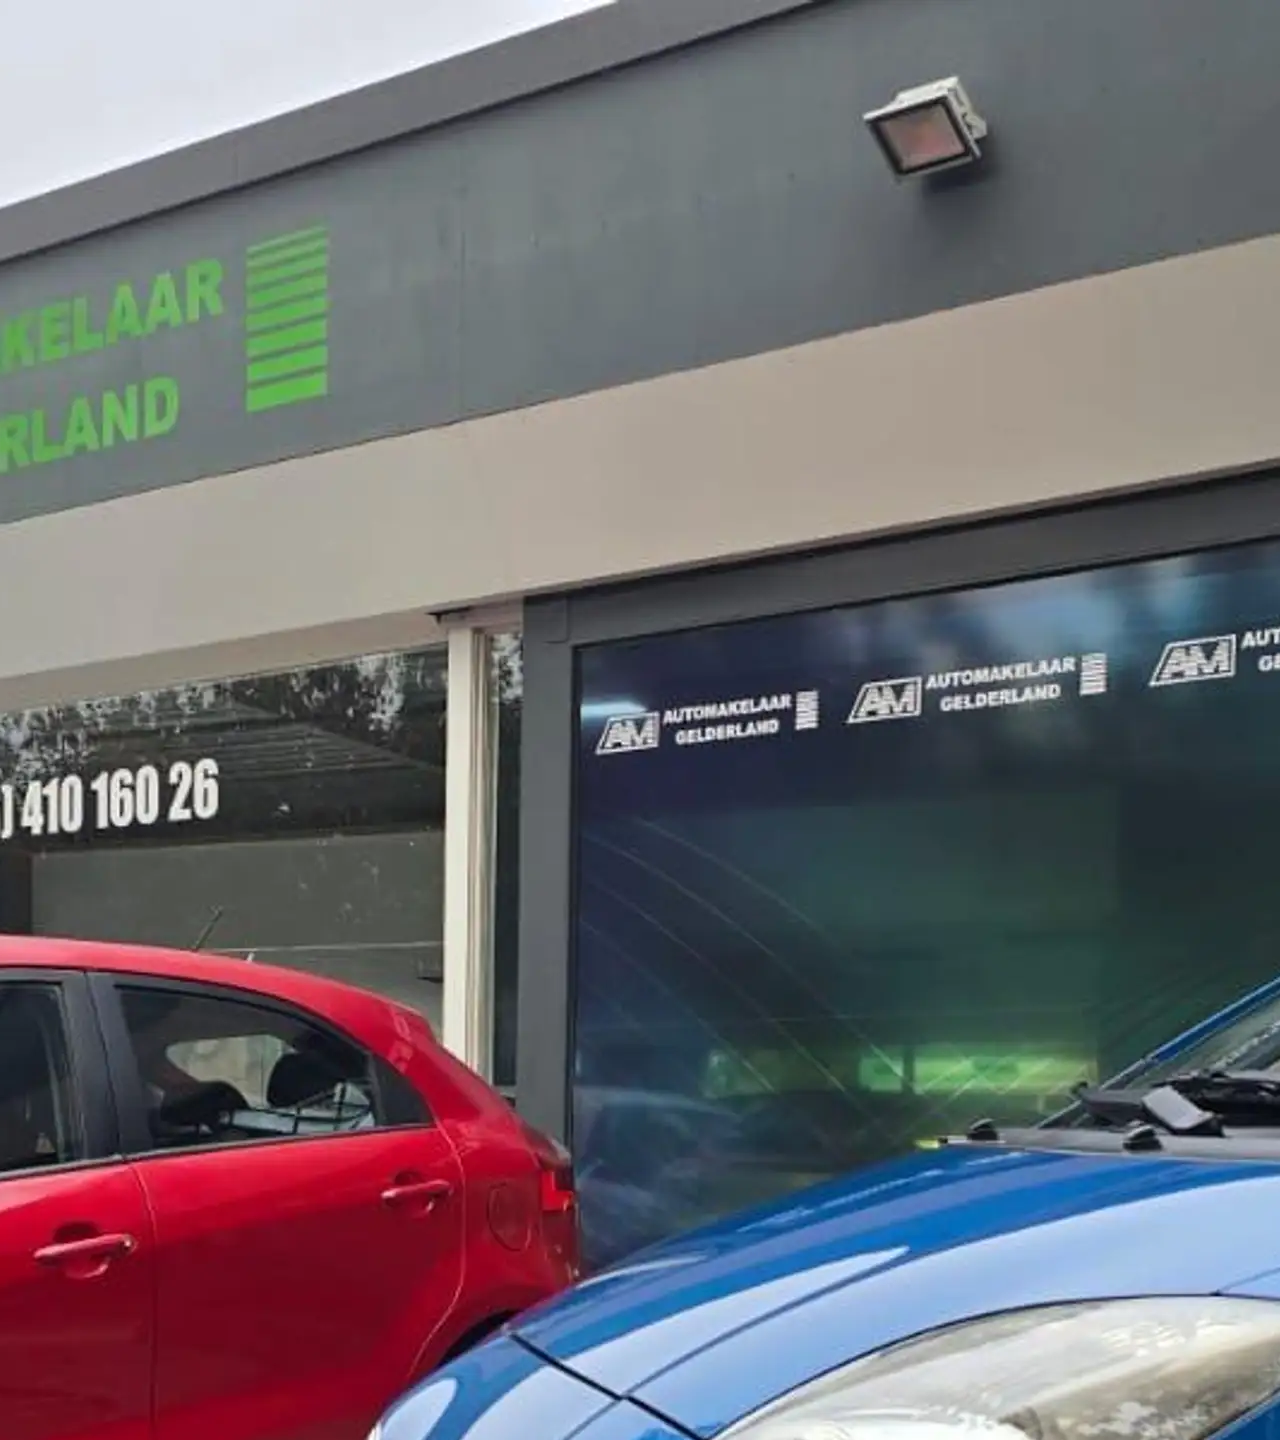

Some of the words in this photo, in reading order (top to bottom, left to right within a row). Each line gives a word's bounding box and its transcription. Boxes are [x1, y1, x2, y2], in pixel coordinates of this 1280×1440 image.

[925, 656, 1077, 690] AUTOMAKELAAR
[1158, 640, 1229, 679] AM
[662, 693, 792, 725] AUTOMAKELAAR
[857, 683, 915, 717] AM
[939, 683, 1062, 712] GELDERLAND
[602, 719, 656, 749] AM
[674, 718, 780, 745] GELDERLAND
[20, 774, 84, 837] 410
[90, 764, 161, 830] 160
[167, 757, 220, 822] 26
